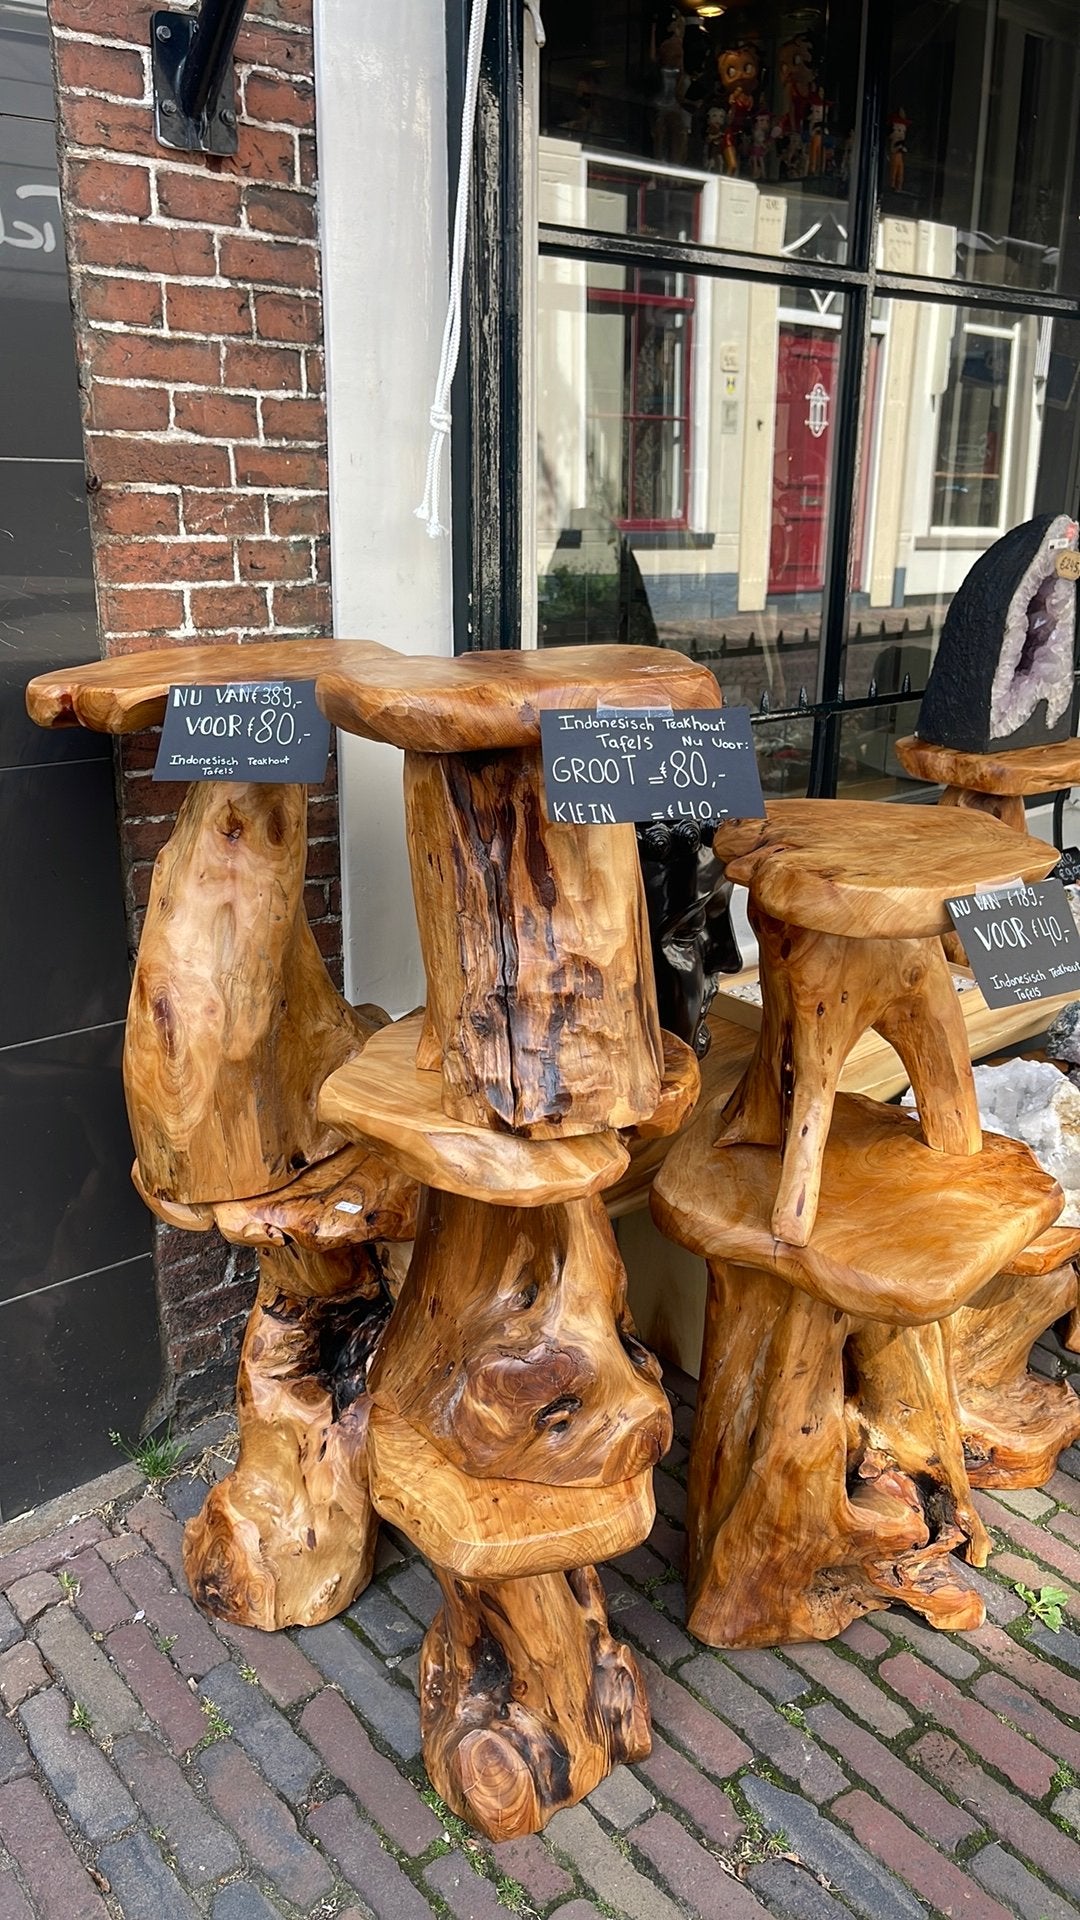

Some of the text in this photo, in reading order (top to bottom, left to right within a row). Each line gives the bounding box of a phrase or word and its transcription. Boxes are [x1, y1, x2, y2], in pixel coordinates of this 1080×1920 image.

[173, 688, 202, 707] NU
[185, 714, 243, 737] VOOR
[558, 715, 726, 732] Indonesisch Teakhout
[596, 733, 653, 752] Tafels
[682, 736, 703, 747] Nu
[169, 755, 290, 766] Indonesisch Teakhout
[552, 754, 637, 785] GROOT
[202, 767, 234, 776] Tafels
[553, 801, 617, 824] KLEIN
[949, 900, 971, 918] NU
[974, 894, 1001, 911] VAN
[973, 917, 1033, 951] VOOR
[990, 970, 1046, 990] Indonesisch
[1014, 986, 1042, 1001] Tafels
